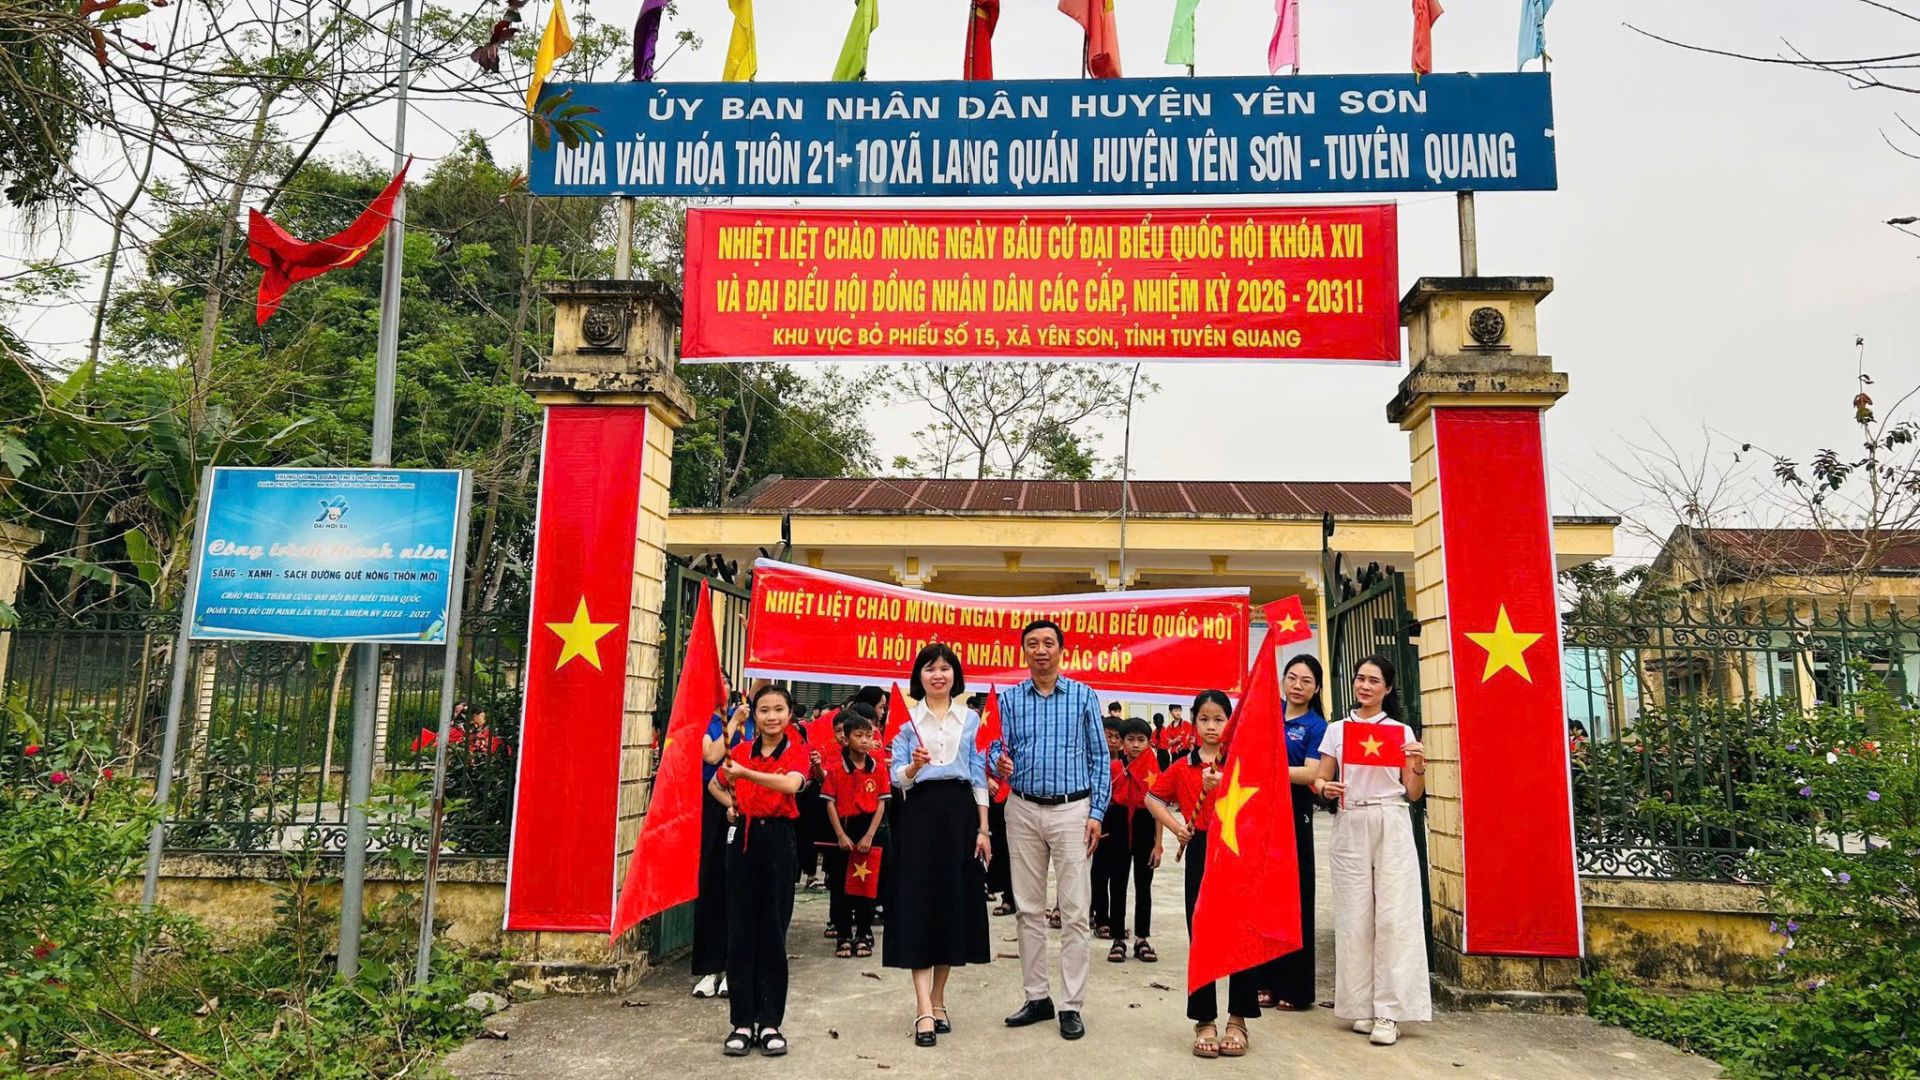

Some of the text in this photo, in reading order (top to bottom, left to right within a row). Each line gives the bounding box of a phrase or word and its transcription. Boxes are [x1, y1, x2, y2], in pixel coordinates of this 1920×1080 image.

[648, 85, 1427, 122] ỦY BAN NHÂN DÂN HUYỆN YÊN SƠN
[554, 130, 607, 185] NHÀ
[616, 132, 666, 185] VĂN
[675, 130, 726, 185] HÓA
[735, 131, 801, 185] THÔN
[932, 138, 999, 185] LANG
[1008, 129, 1079, 190] QUÁN
[1093, 128, 1178, 189] HUYỆN
[1187, 127, 1238, 182] YÊN
[1249, 132, 1302, 182] SƠN
[1424, 131, 1518, 185] QUANG
[718, 213, 1363, 267] NHIỆT LIỆT CHÀO MỪNG NGÀY BẦU CỬ ĐẠI BIỂU QUỐC HỘI KHÓA XVI
[717, 272, 741, 313] VÀ
[746, 279, 779, 319] ĐẠI
[784, 266, 829, 312] BIỂU
[834, 272, 867, 319] HỘI
[872, 268, 926, 312] ĐỒNG
[932, 272, 987, 312] NHÂN
[993, 272, 1034, 312] DÂN
[1040, 272, 1079, 312] CÁC
[1085, 267, 1128, 316] CẤP,
[1133, 272, 1199, 320] NHIỆM
[1205, 272, 1231, 313] KỲ
[1237, 279, 1287, 313] 2026
[1306, 279, 1363, 313] 2031!
[773, 320, 1302, 351] KHU VỰC BỎ PHIẾU SỐ 15, XÃ YÊN SƠN, TỈNH TUYÊN QUANG
[248, 569, 273, 578] XANH
[765, 588, 815, 620] NHIỆT
[817, 590, 851, 622] LIỆT
[855, 593, 901, 622] CHÀO
[1076, 610, 1105, 639] ĐẠI
[1109, 605, 1149, 636] BIỂU
[1152, 608, 1199, 638] QUỐC
[1203, 612, 1232, 644] HỘI
[857, 632, 878, 660] VÀ
[882, 633, 911, 665] HỘI
[967, 640, 1015, 668] NHÂN
[1058, 645, 1093, 671] CÁC
[1097, 643, 1133, 673] CẤP
